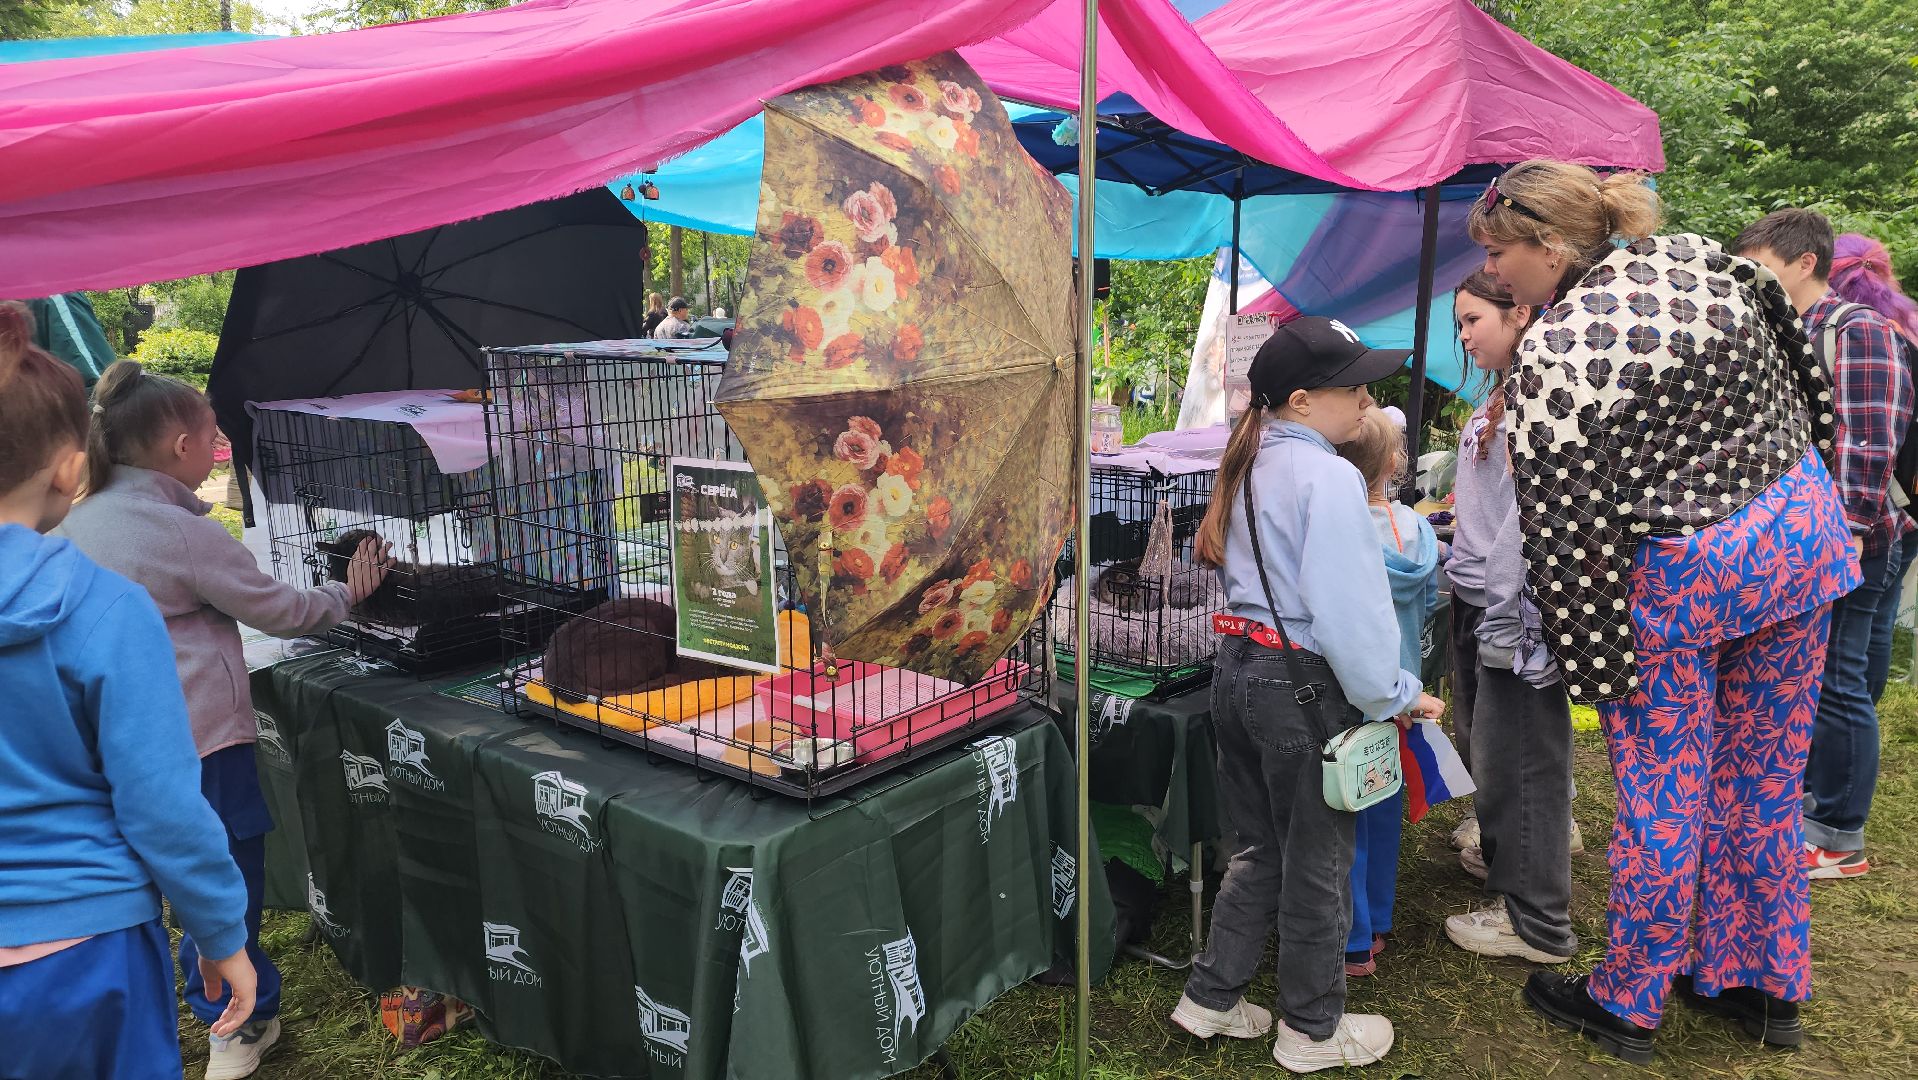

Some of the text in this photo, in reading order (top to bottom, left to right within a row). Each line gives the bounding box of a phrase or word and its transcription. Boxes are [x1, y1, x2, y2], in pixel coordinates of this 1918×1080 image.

[701, 484, 738, 499] СЕРЁГА
[718, 590, 737, 599] года
[1218, 619, 1237, 630] Tok
[423, 776, 445, 791] ДОМ
[977, 809, 989, 845] ДОМ
[513, 969, 542, 989] ДОМ
[864, 944, 897, 1064] УЮТНЫЙ ДОМ
